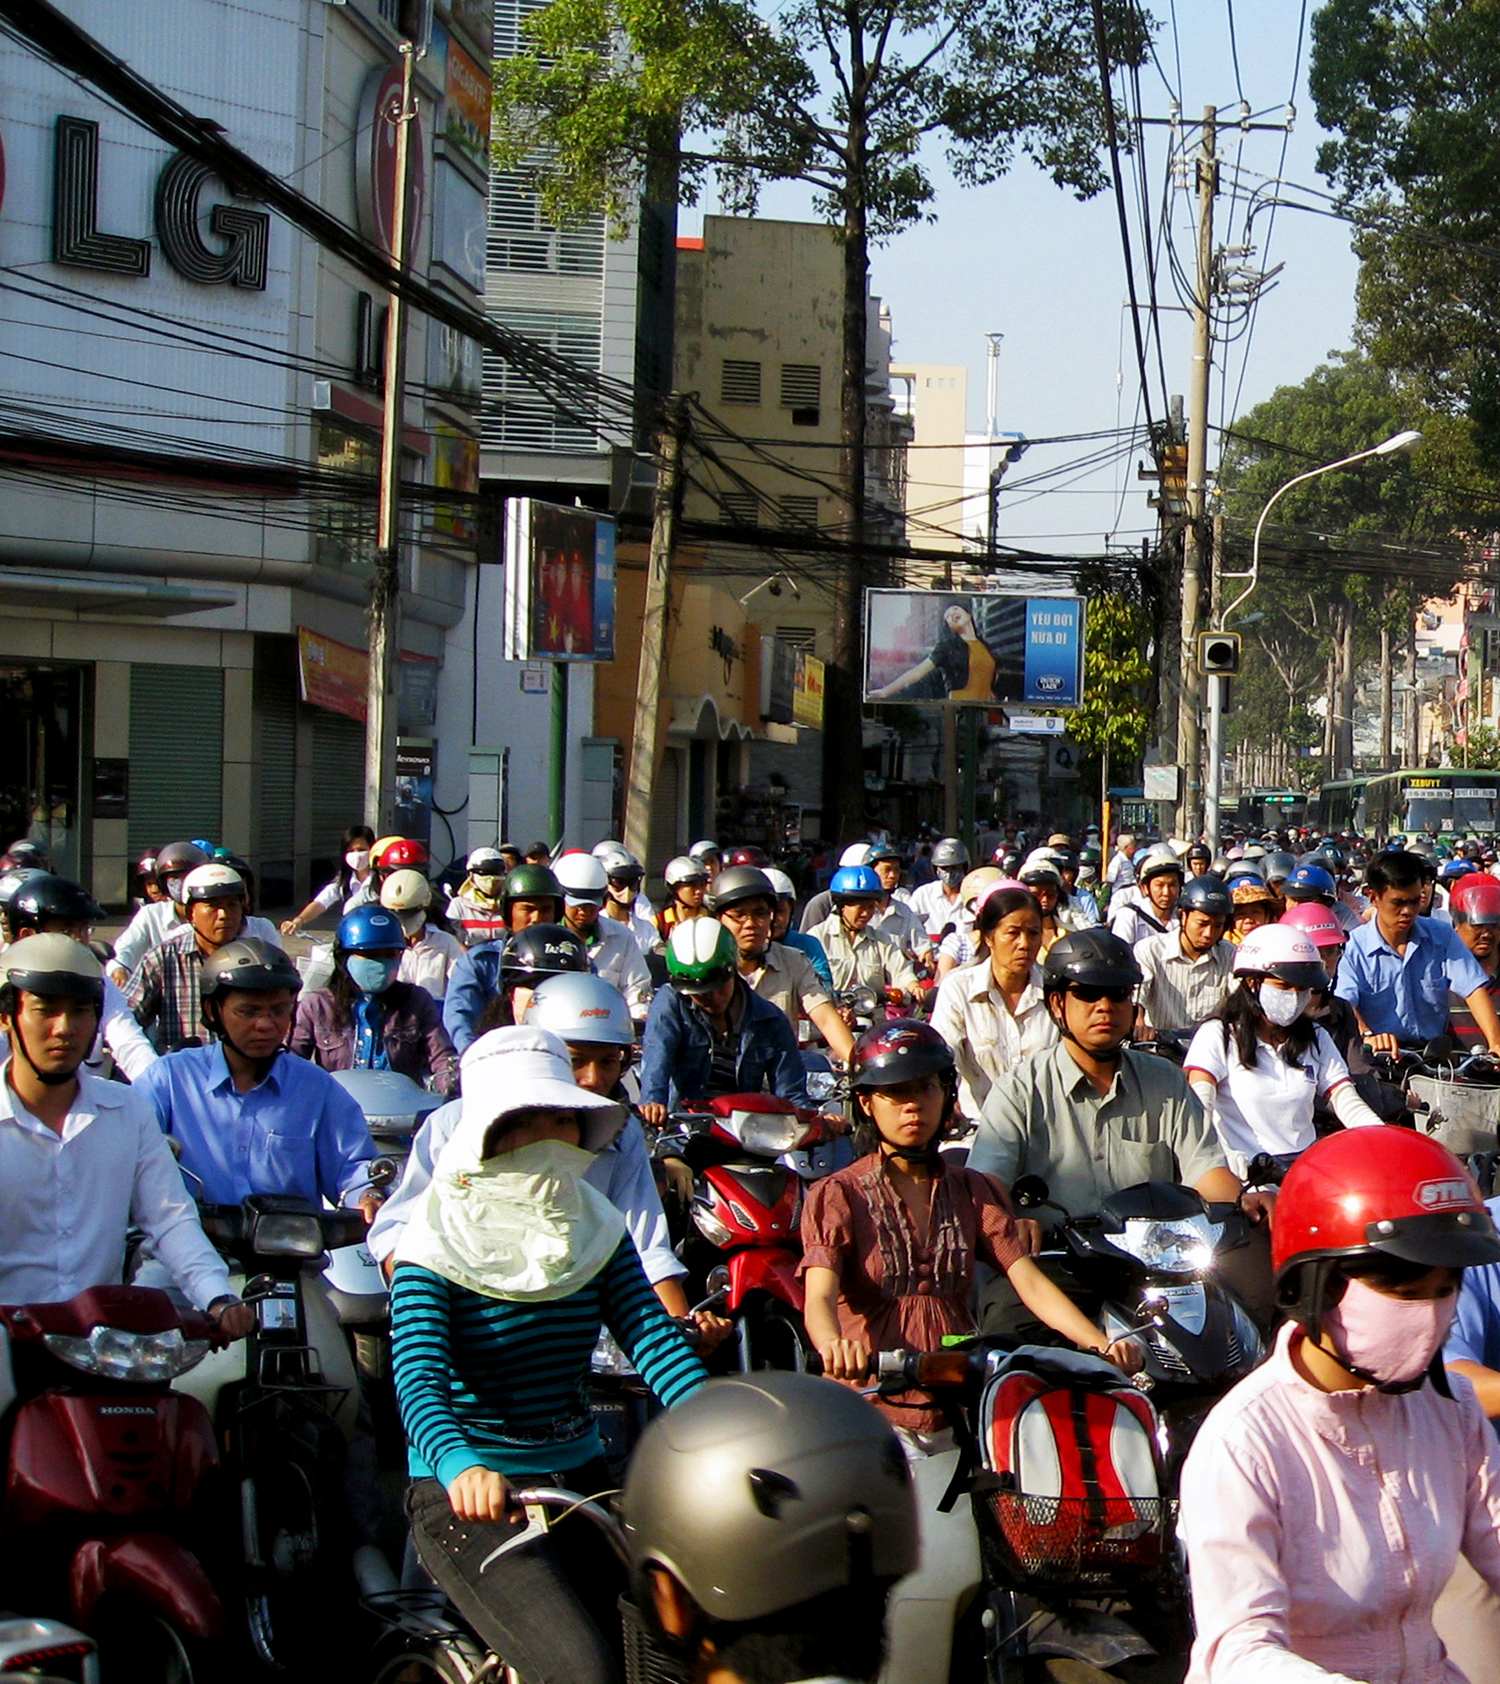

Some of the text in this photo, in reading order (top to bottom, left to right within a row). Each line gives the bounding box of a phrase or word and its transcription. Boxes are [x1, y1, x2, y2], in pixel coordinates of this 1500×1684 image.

[55, 114, 269, 291] LG
[396, 754, 430, 763] lenovo
[101, 1406, 155, 1415] HONDA
[590, 1403, 623, 1412] NDA
